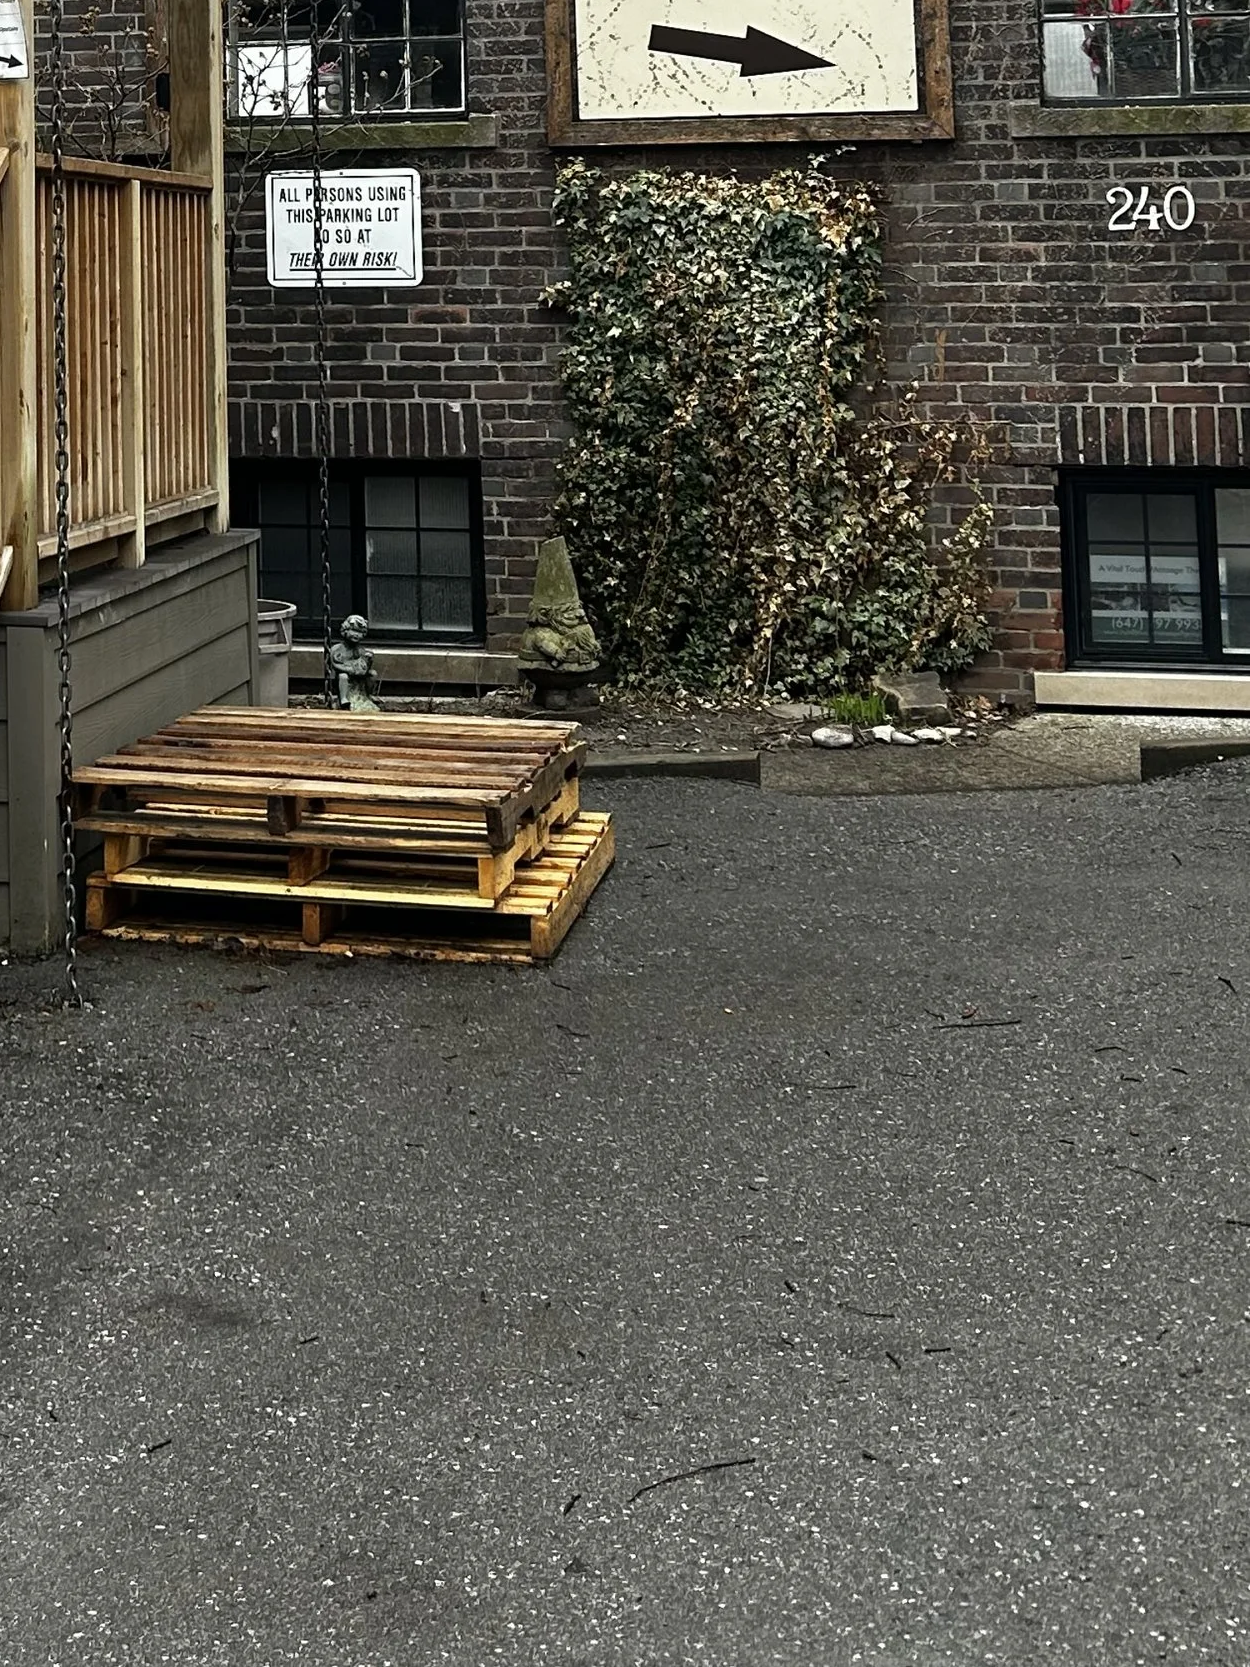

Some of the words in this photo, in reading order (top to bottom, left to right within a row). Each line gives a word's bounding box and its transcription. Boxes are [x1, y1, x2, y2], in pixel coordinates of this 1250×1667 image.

[279, 188, 301, 203] ALL
[306, 187, 362, 202] PRSONS
[368, 186, 406, 201] USING
[286, 208, 313, 223] THIS
[378, 207, 400, 222] LOT
[1105, 185, 1196, 231] 240
[316, 229, 330, 244] O
[335, 228, 352, 244] SO
[357, 228, 372, 243] AT
[329, 252, 358, 267] OWN
[362, 251, 398, 267] RISK!
[1111, 617, 1144, 630] (647)
